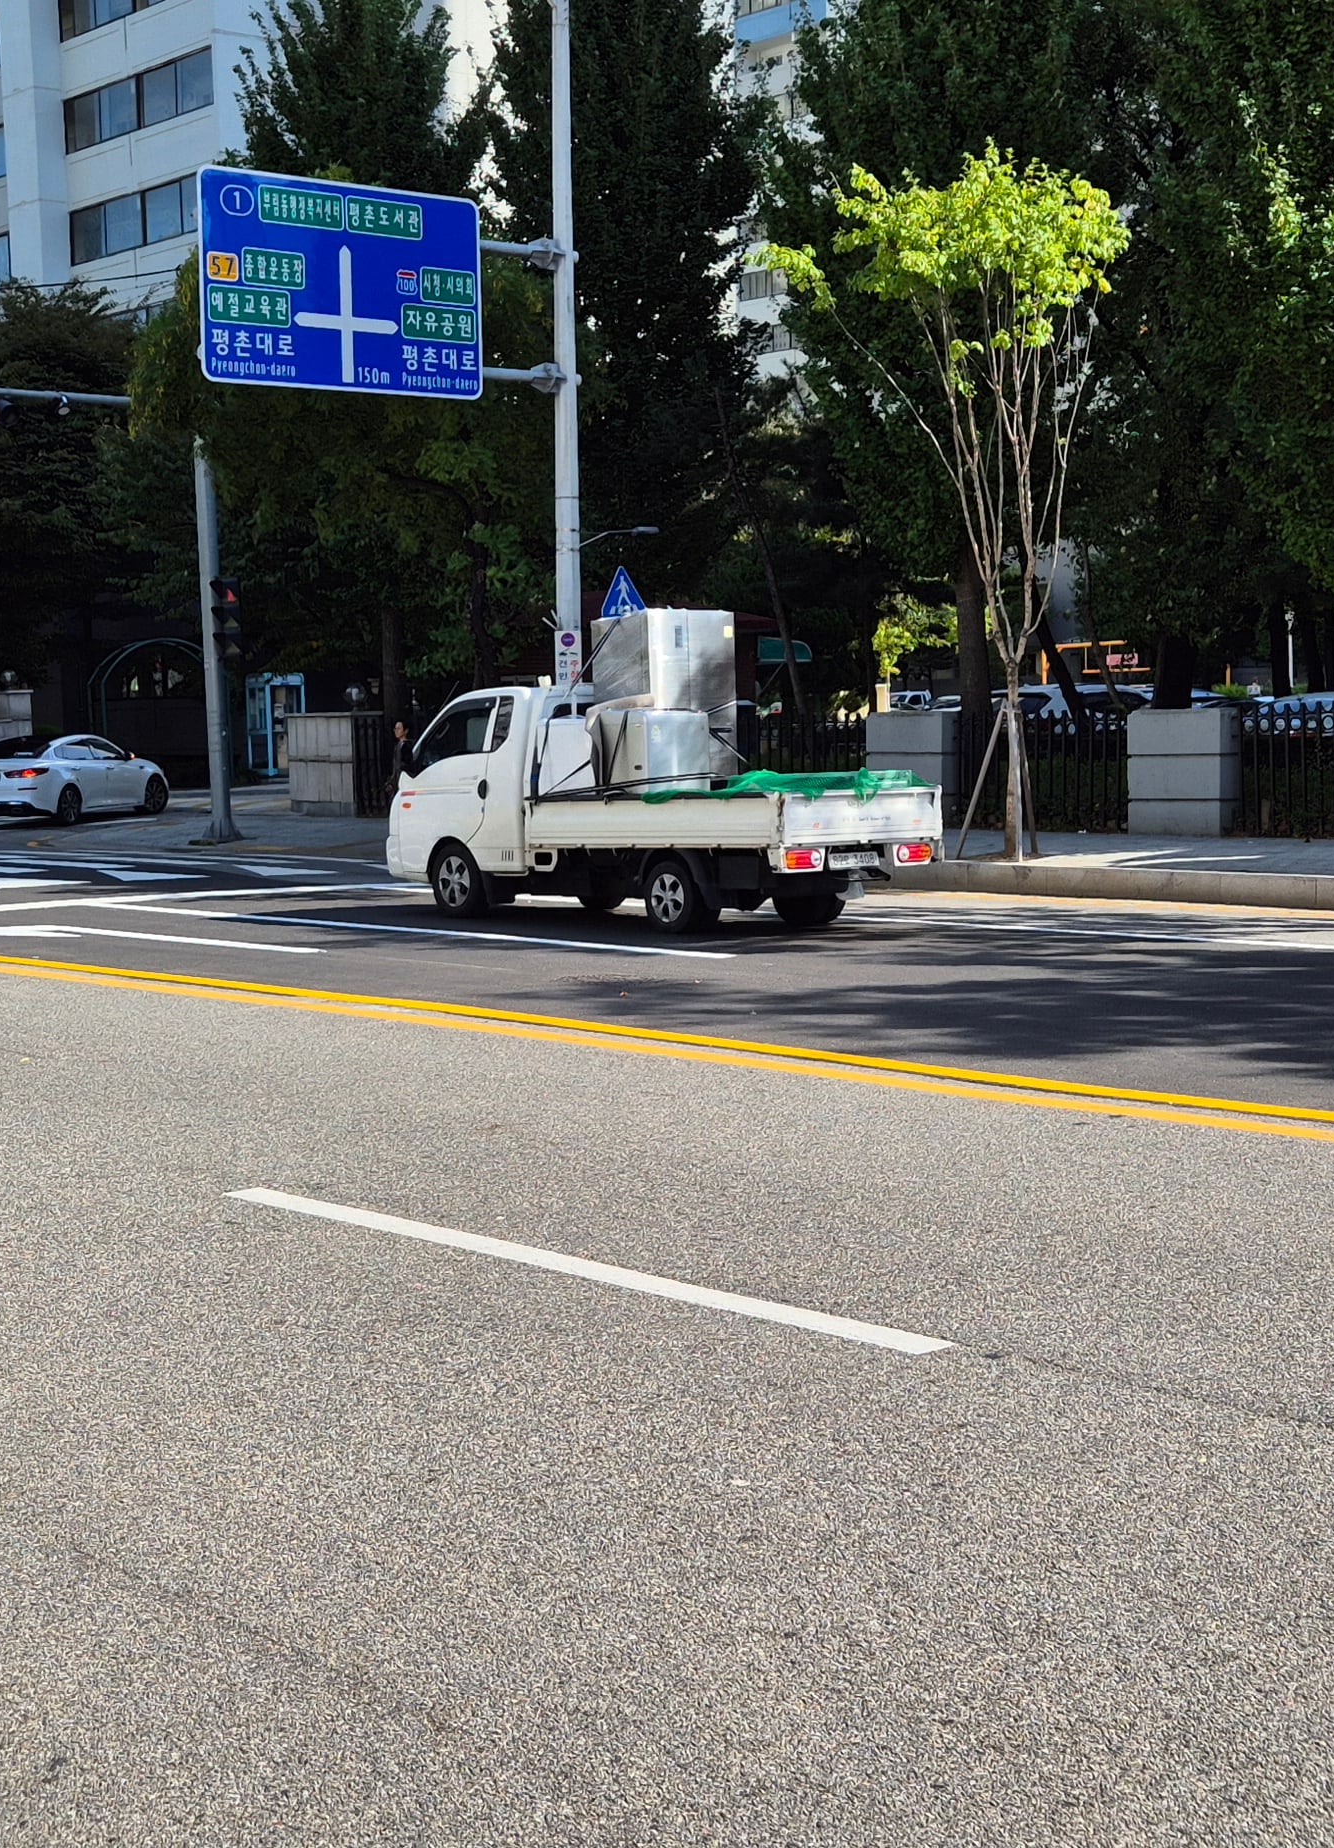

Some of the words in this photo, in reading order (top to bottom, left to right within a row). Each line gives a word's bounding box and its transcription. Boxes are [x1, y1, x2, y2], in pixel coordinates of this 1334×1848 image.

[233, 191, 241, 210] 1
[263, 191, 340, 222] 부림동행정복지센터
[349, 202, 419, 233] 평촌도서관
[211, 255, 236, 277] 57
[245, 254, 303, 283] 종합운동장
[399, 278, 415, 292] 100
[211, 291, 288, 320] 예절교육관
[405, 310, 472, 338] 자유공원
[211, 328, 295, 357] 평촌대로
[211, 356, 296, 377] Pyeongchon-daero
[402, 344, 477, 372] 평촌대로
[357, 366, 391, 386] 150m
[402, 371, 478, 391] Pyeongchon-daero
